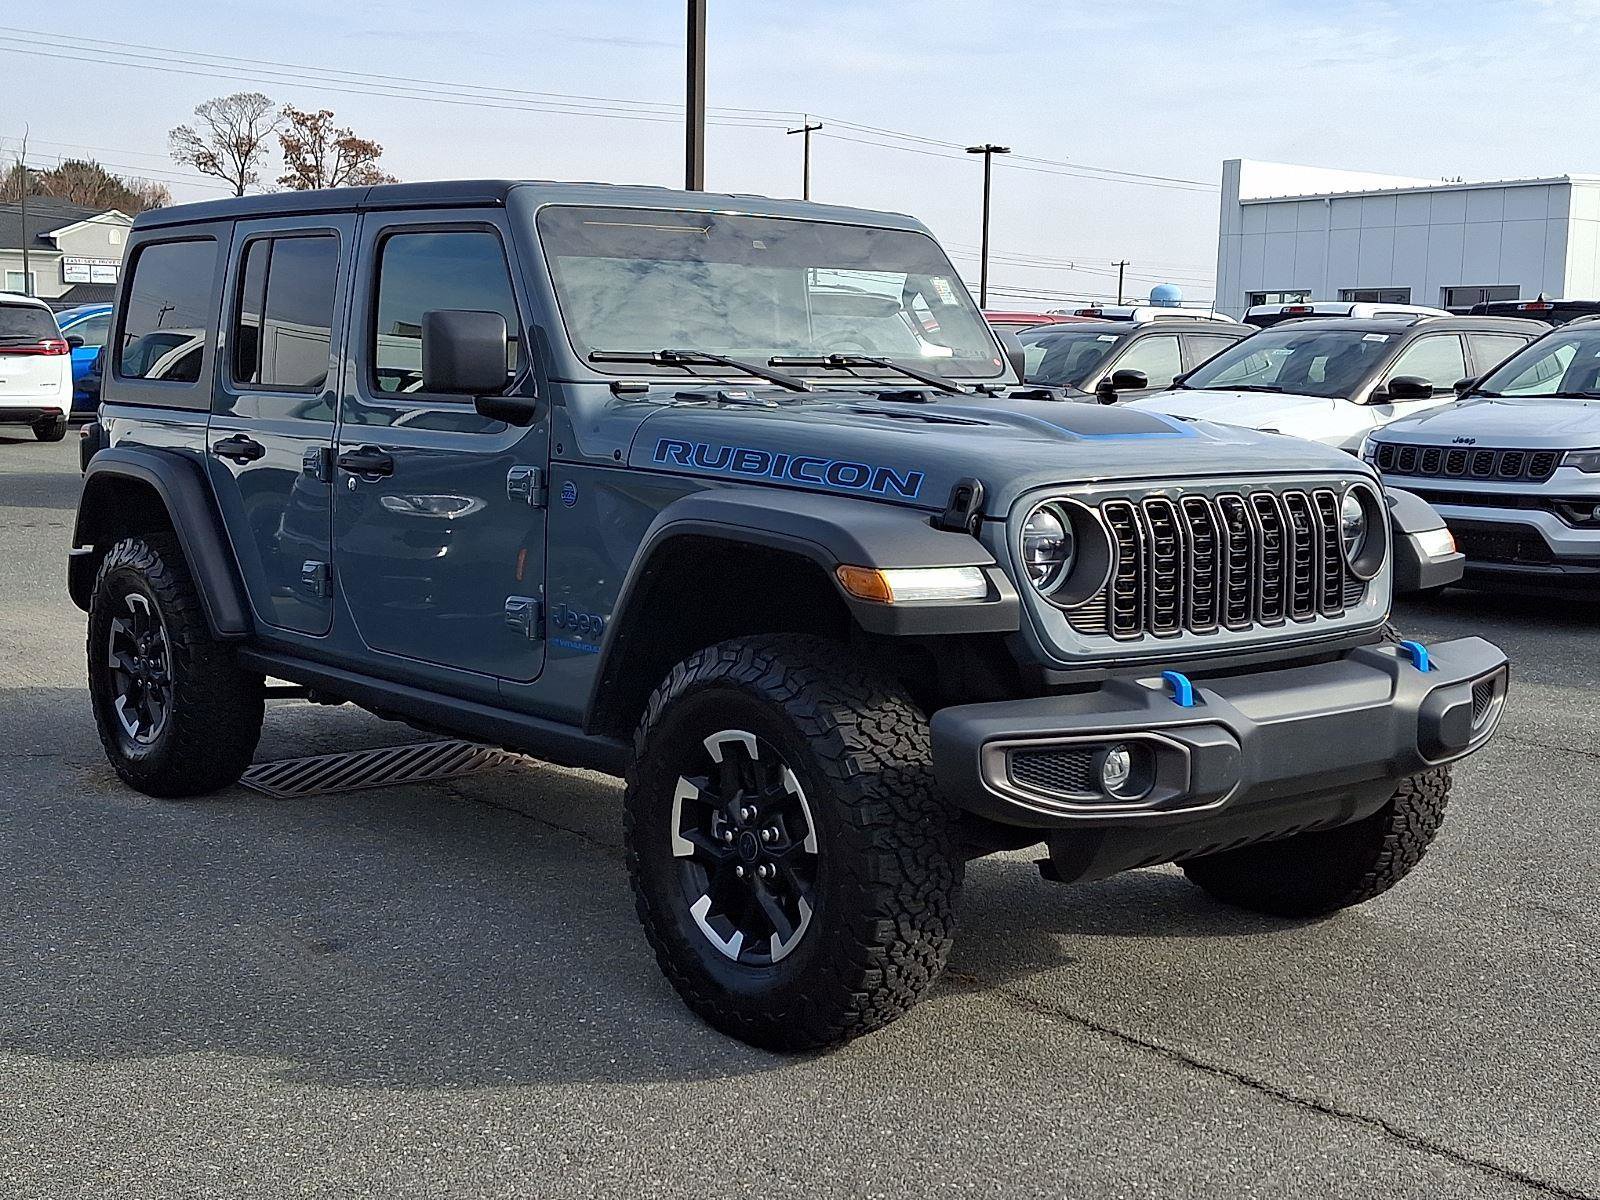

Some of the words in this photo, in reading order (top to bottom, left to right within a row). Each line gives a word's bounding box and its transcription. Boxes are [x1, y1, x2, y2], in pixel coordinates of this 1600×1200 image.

[1452, 436, 1476, 445] Jeep
[653, 437, 925, 498] RUBICON
[552, 602, 604, 640] Jeep
